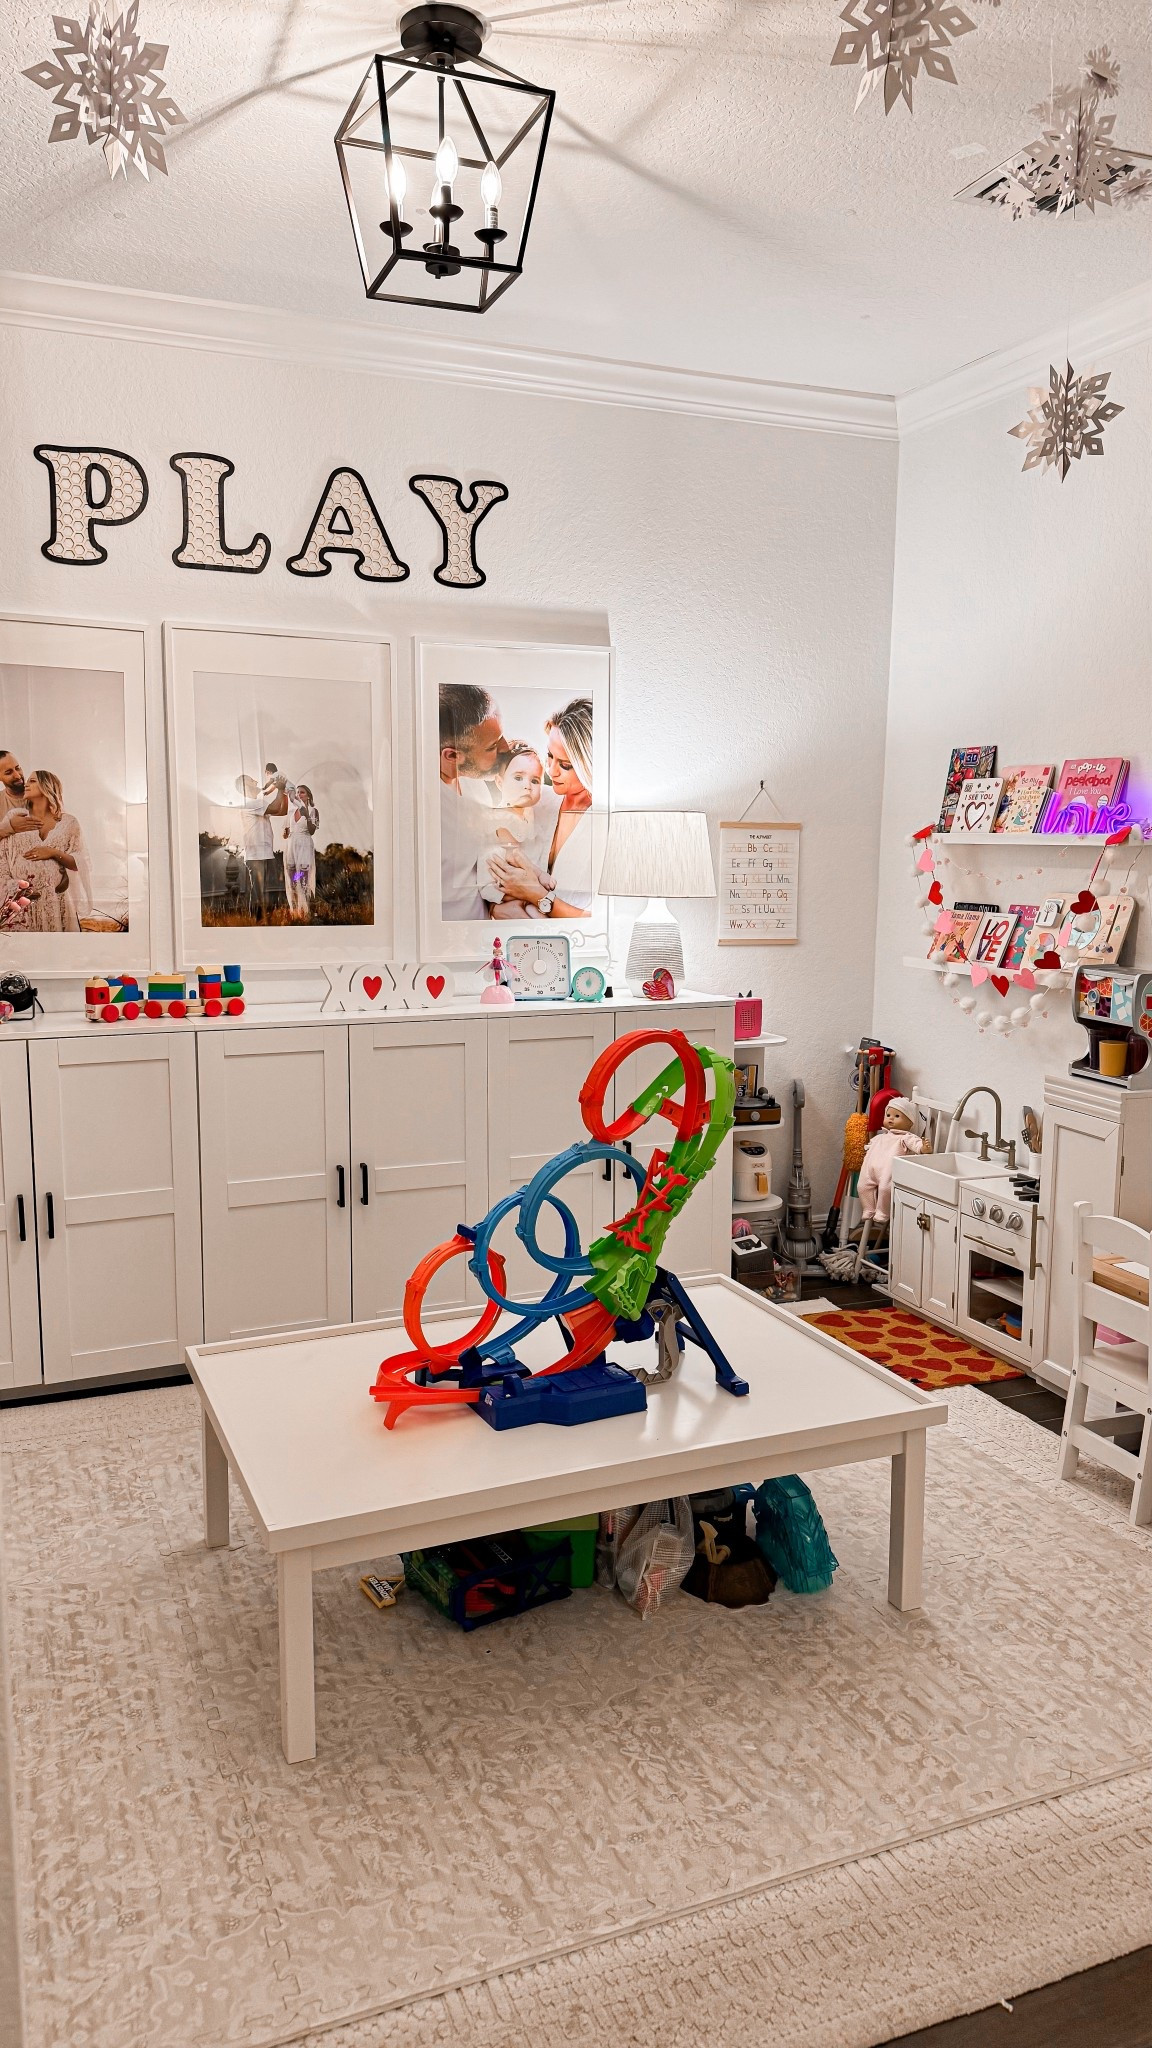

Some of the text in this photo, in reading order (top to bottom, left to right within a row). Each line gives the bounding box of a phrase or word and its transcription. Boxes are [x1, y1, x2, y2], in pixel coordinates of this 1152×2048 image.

[34, 443, 509, 589] PLAY
[748, 843, 757, 852] Bb
[763, 844, 772, 852] Cc
[731, 859, 740, 868] Ee
[748, 859, 756, 868] Ff
[763, 859, 772, 871] Gg
[777, 874, 790, 883] Mm
[730, 889, 740, 898] Nn
[763, 889, 771, 901] Pp
[777, 889, 788, 901] Qq
[742, 904, 750, 913] Ss
[764, 904, 775, 913] Uu
[730, 920, 742, 928] Ww
[746, 920, 756, 928] Xx
[776, 920, 786, 928] Zz
